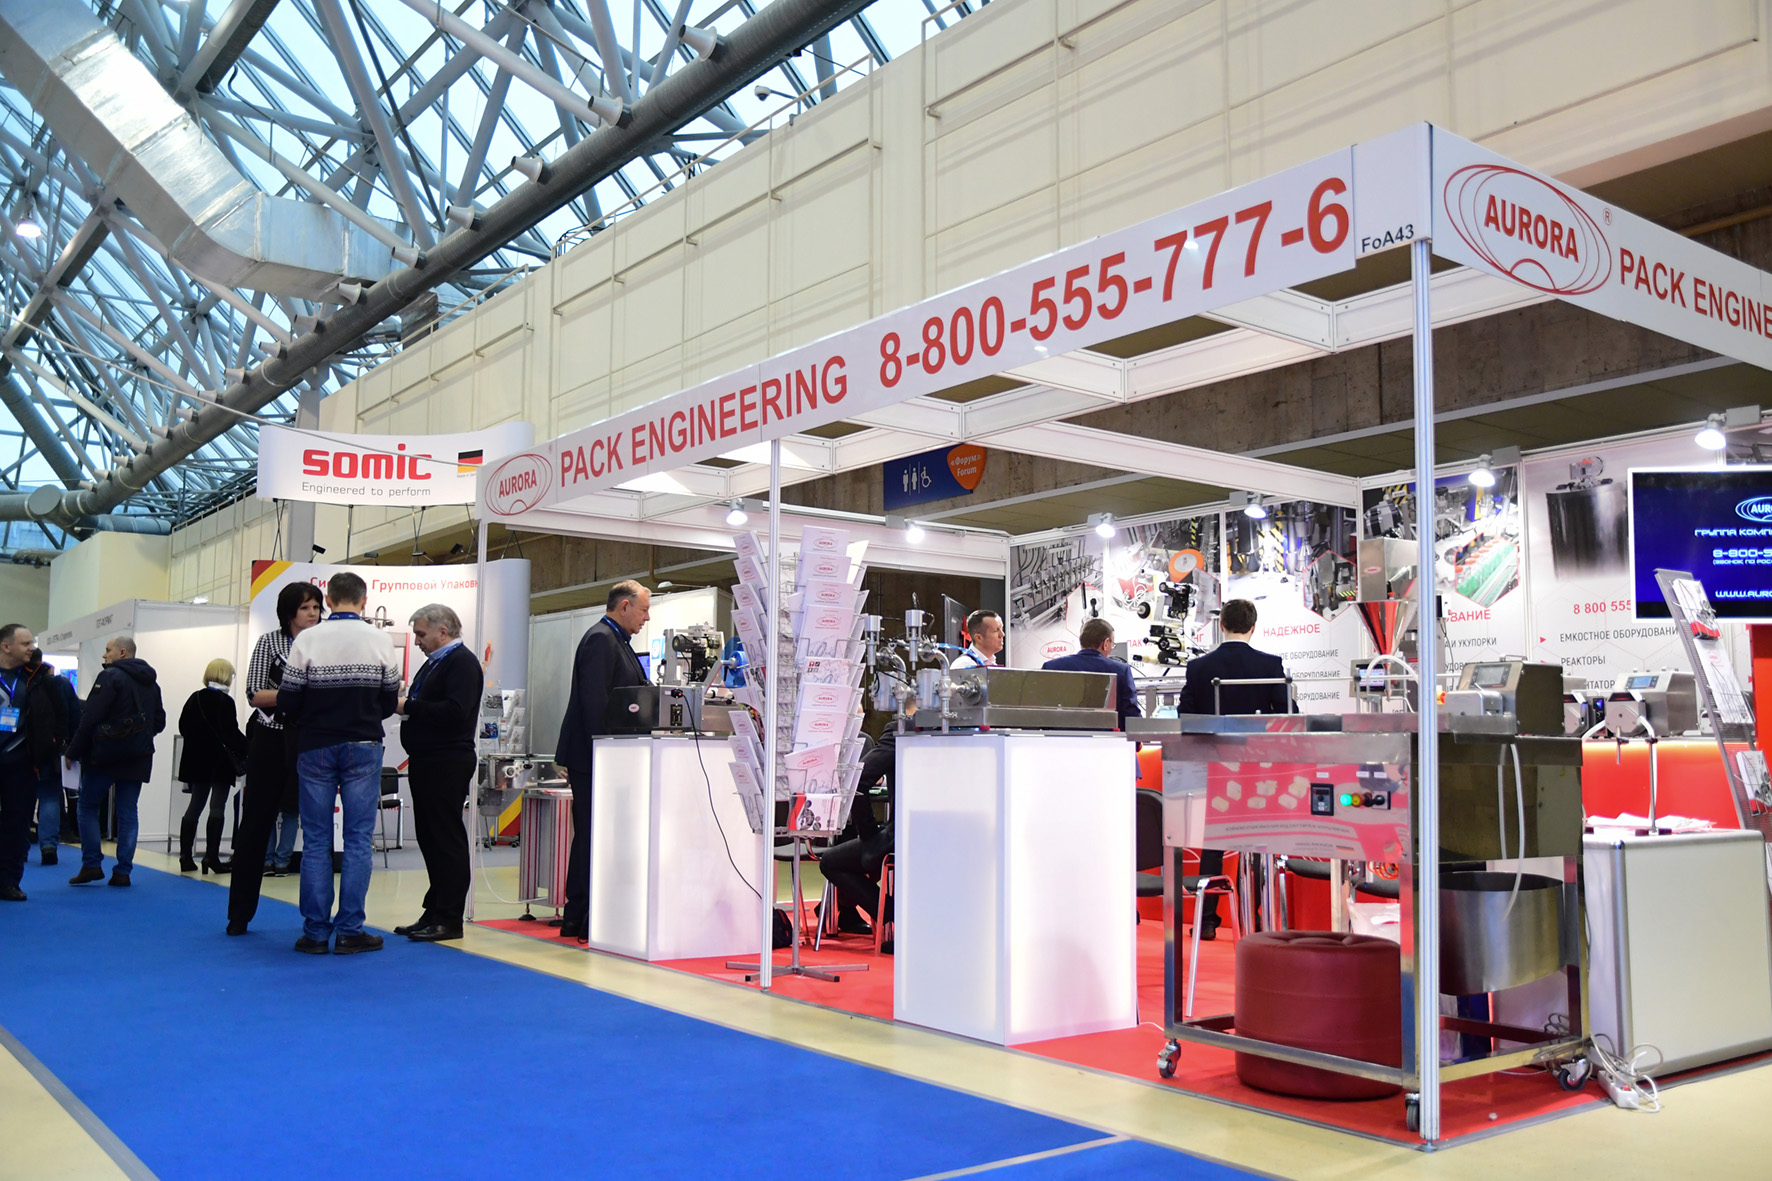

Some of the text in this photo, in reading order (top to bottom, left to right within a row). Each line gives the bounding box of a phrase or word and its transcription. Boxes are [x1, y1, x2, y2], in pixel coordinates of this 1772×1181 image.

[1484, 194, 1579, 263] AURORA
[1361, 224, 1415, 253] FoA43
[879, 177, 1350, 388] 8-800-555-777-6
[1619, 247, 1687, 309] PACK
[561, 355, 848, 488] PACK ENGINEERING
[951, 454, 981, 466] «Форум»
[957, 467, 977, 477] Forum
[302, 482, 431, 498] Engineered to perform
[499, 469, 538, 499] AURORA
[1694, 528, 1772, 537] ГРУППА КОМП
[372, 578, 438, 593] Групповой
[1573, 604, 1580, 615] 8
[1584, 602, 1607, 614] 800
[1263, 624, 1321, 638] НАДЕЖНОЕ
[1560, 626, 1680, 642] ЕМКОСТНОЕ ОБОРУДОВАНИ
[1047, 645, 1067, 653] AURORA
[1458, 637, 1497, 648] УКУПОРКИ
[1289, 649, 1339, 661] ОБОРУДОВАНИЕ
[1561, 656, 1606, 666] РЕАКТОРЫ
[1296, 691, 1340, 702] БОРУДОВАНИЕ
